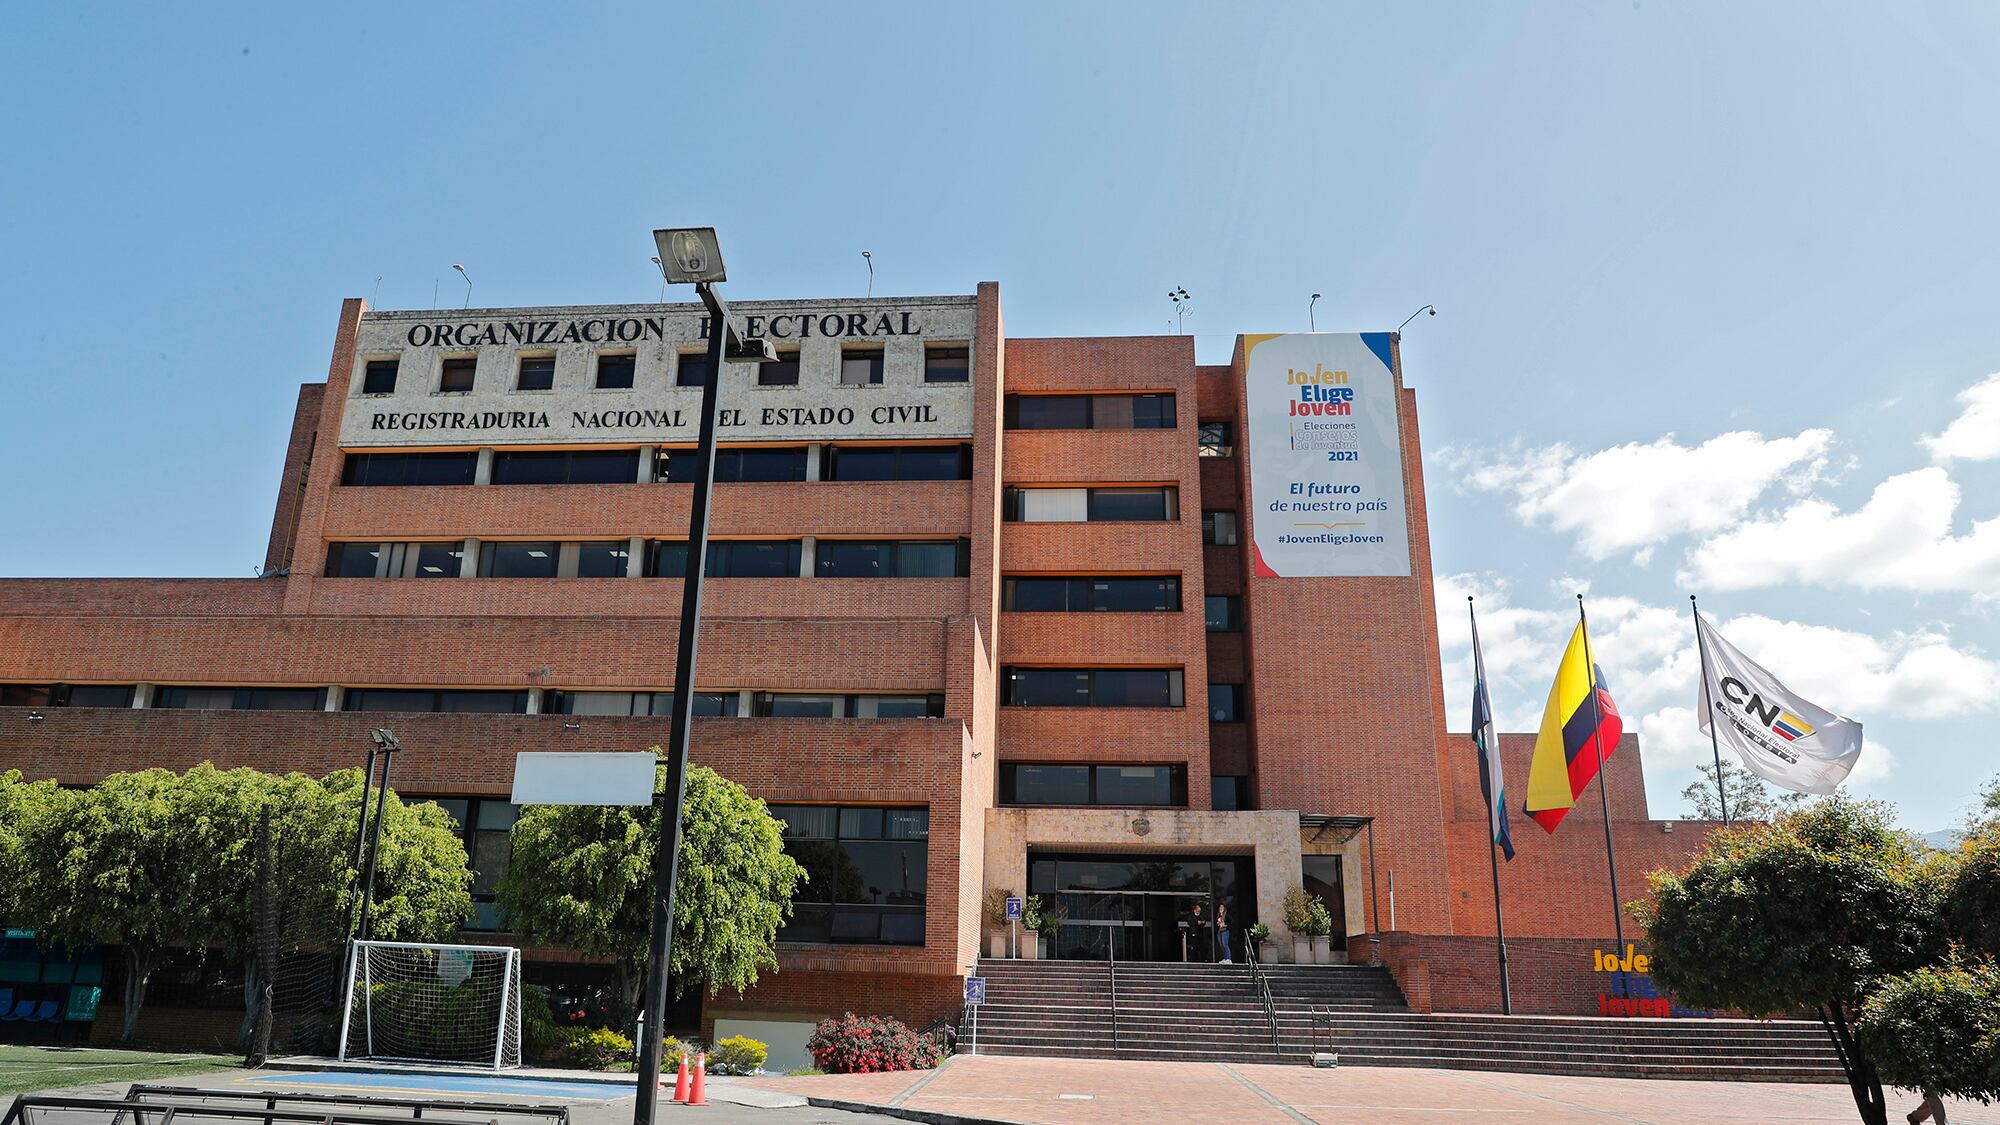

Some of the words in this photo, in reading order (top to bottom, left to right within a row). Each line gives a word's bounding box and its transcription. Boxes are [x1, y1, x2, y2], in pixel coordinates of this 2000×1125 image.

[407, 317, 666, 347] ORGANIZACION
[698, 311, 922, 340] EECTORAL
[1287, 363, 1348, 385] Joven
[1301, 384, 1353, 404] Elige
[1289, 399, 1351, 416] Joven
[371, 411, 550, 430] REGISTRADURIA
[572, 409, 687, 428] NACIONAL
[717, 408, 747, 427] EL
[760, 406, 855, 426] ESTADO
[870, 405, 938, 424] CIVIL
[1303, 422, 1356, 431] Elecciones
[1295, 430, 1358, 441] Consejos
[1296, 441, 1309, 450] de
[1328, 451, 1358, 461] 2021
[1290, 482, 1303, 494] El
[1308, 482, 1361, 497] futuro
[1270, 500, 1288, 511] de
[1293, 501, 1352, 511] nuestro
[1356, 498, 1388, 514] país
[1278, 534, 1384, 545] #JovenEligeJoven
[1738, 717, 1768, 739] Nacional
[1768, 737, 1801, 759] Electoral
[1594, 943, 1649, 973] Jove
[1599, 994, 1670, 1017] Joven
